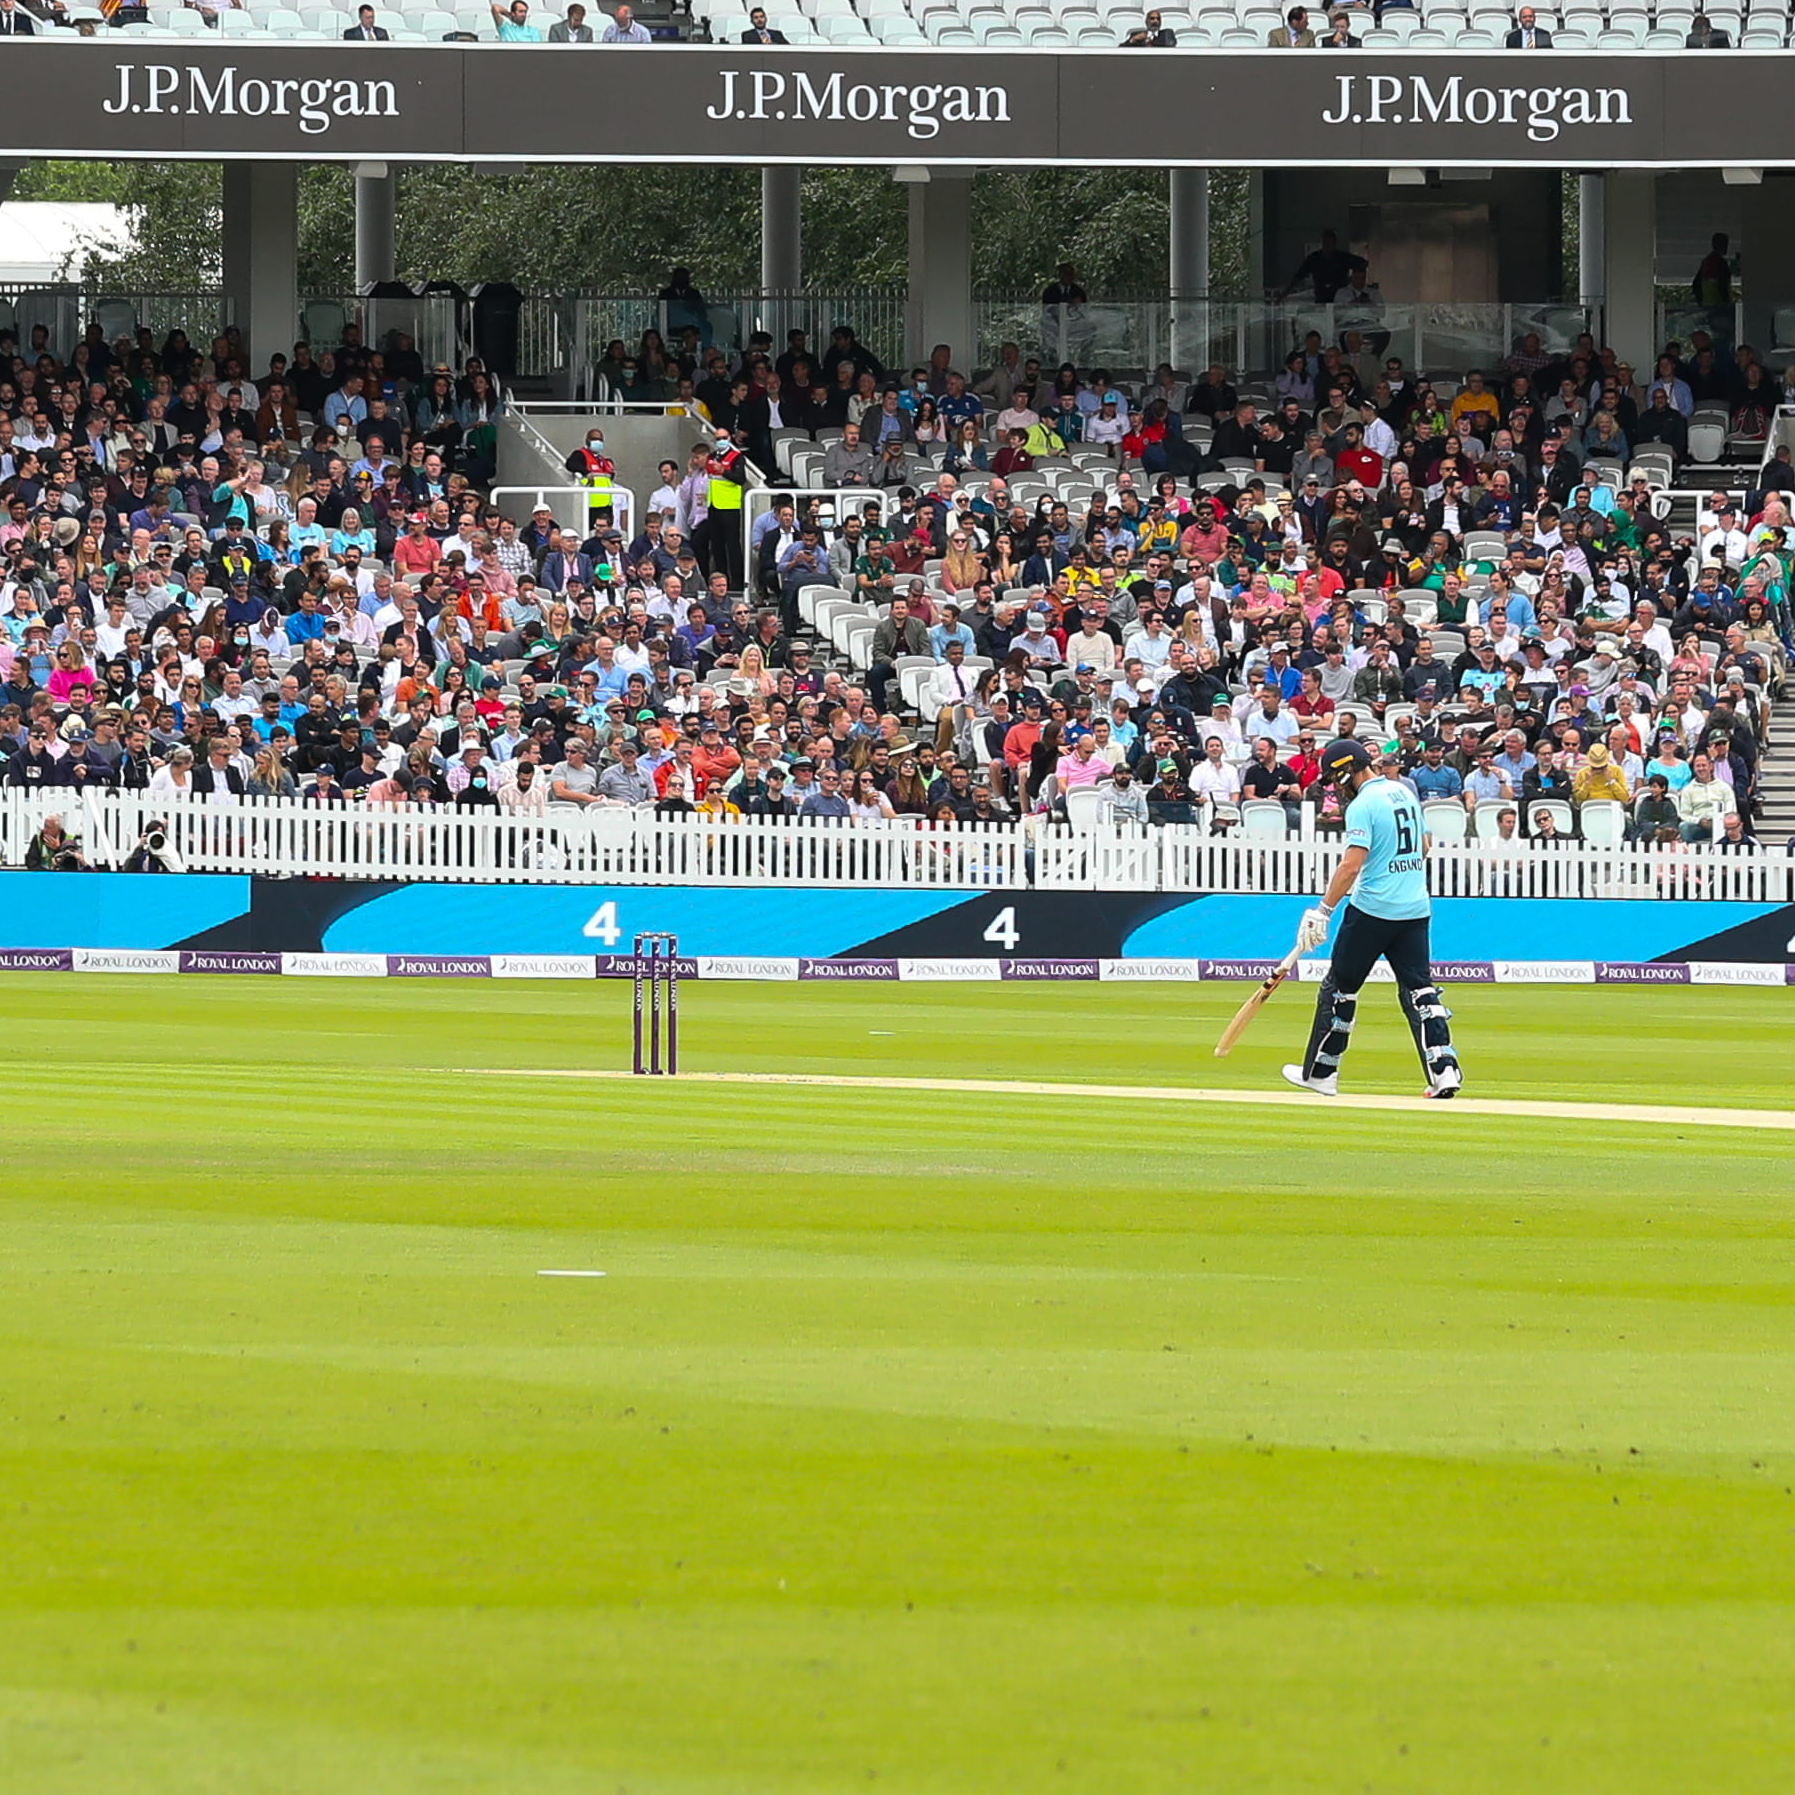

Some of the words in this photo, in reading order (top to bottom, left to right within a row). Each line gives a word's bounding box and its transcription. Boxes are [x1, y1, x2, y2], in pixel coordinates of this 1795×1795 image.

[104, 65, 399, 133] J.P.Morgan
[707, 72, 1010, 138] J.P.Morgan
[1323, 76, 1632, 141] J.P.Morgan
[1394, 806, 1418, 855] 61
[1389, 858, 1422, 874] ENGLND
[584, 902, 620, 945] 4
[984, 907, 1019, 949] 4
[14, 956, 60, 966] LONDON
[198, 958, 229, 968] ROYAL
[232, 959, 276, 969] LONDON
[407, 963, 440, 973] ROYAL
[442, 963, 486, 973] LONDON
[815, 966, 847, 975] ROYAL
[849, 966, 892, 975] LONDON
[1017, 965, 1048, 975] ROYAL
[1051, 965, 1093, 975] LONDON
[1216, 966, 1246, 976] ROYAL
[1445, 968, 1487, 977] LONDON
[1609, 969, 1639, 978] ROYAL
[1641, 969, 1682, 979] LONDON
